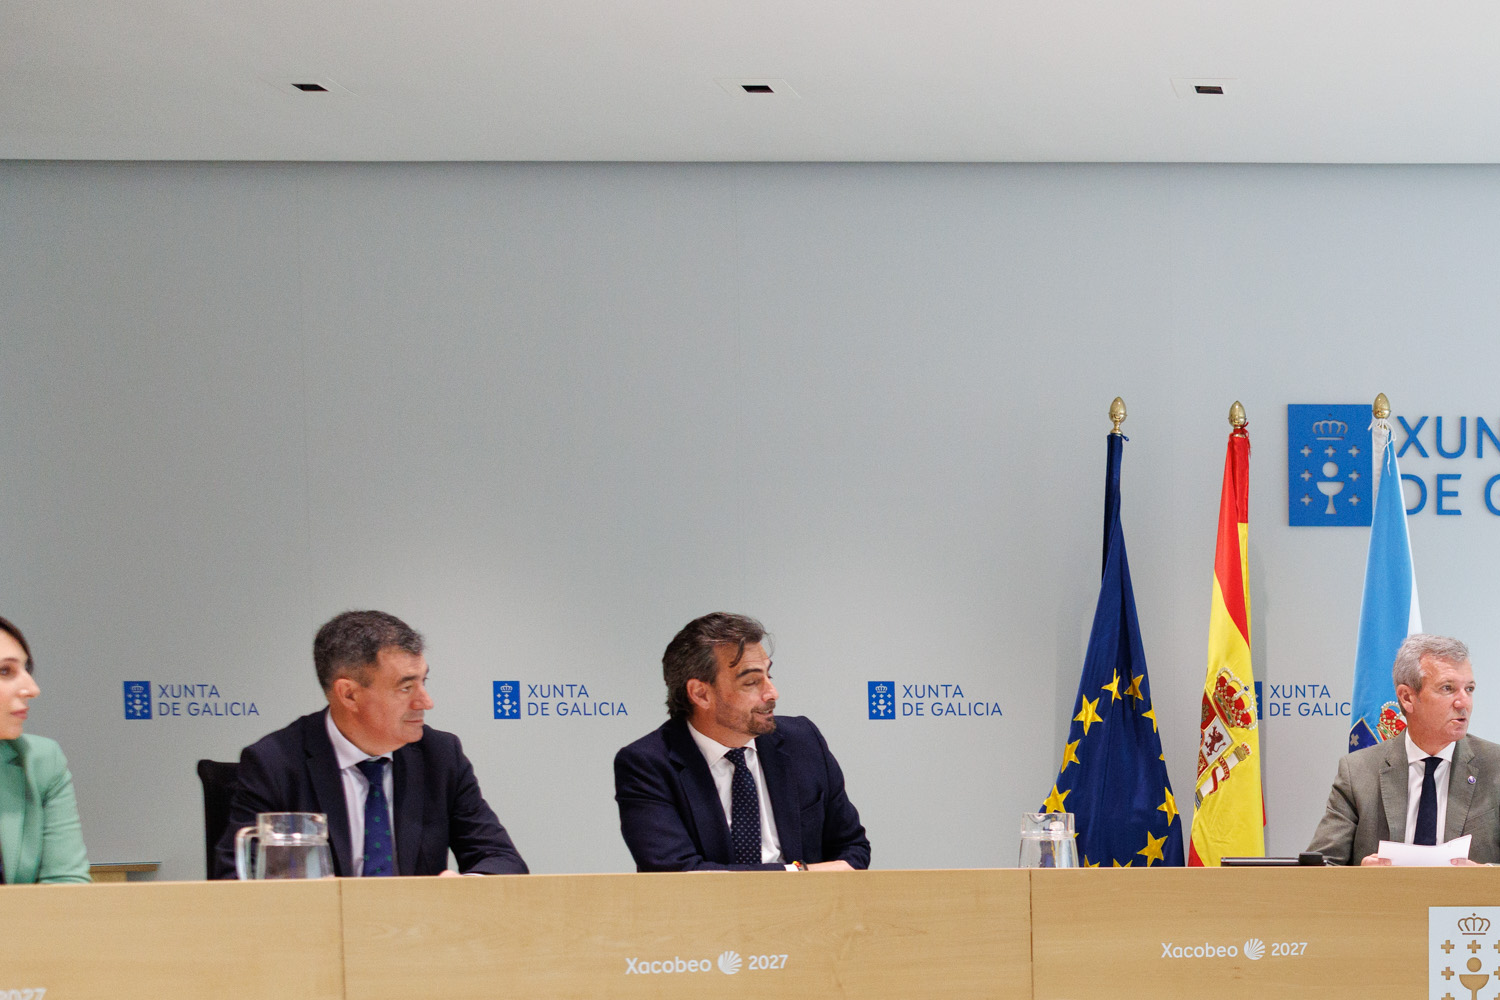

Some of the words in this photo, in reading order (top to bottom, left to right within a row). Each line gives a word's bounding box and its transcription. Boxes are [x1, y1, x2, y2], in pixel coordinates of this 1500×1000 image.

[159, 684, 220, 699] XUNTA
[528, 684, 589, 698] XUNTA
[902, 684, 964, 699] XUNTA
[1269, 684, 1331, 699] XUNTA
[158, 702, 181, 717] DE
[187, 702, 260, 717] GALICIA
[527, 702, 550, 717] DE
[556, 701, 628, 717] GALICIA
[902, 702, 925, 717] DE
[931, 702, 1003, 717] GALICIA
[1269, 702, 1291, 717] DE
[1298, 702, 1351, 717] GALIC
[1161, 941, 1238, 959] Xacobeo
[1271, 941, 1308, 956] 2027
[625, 955, 712, 975] Xacobeo
[748, 953, 788, 971] 2027
